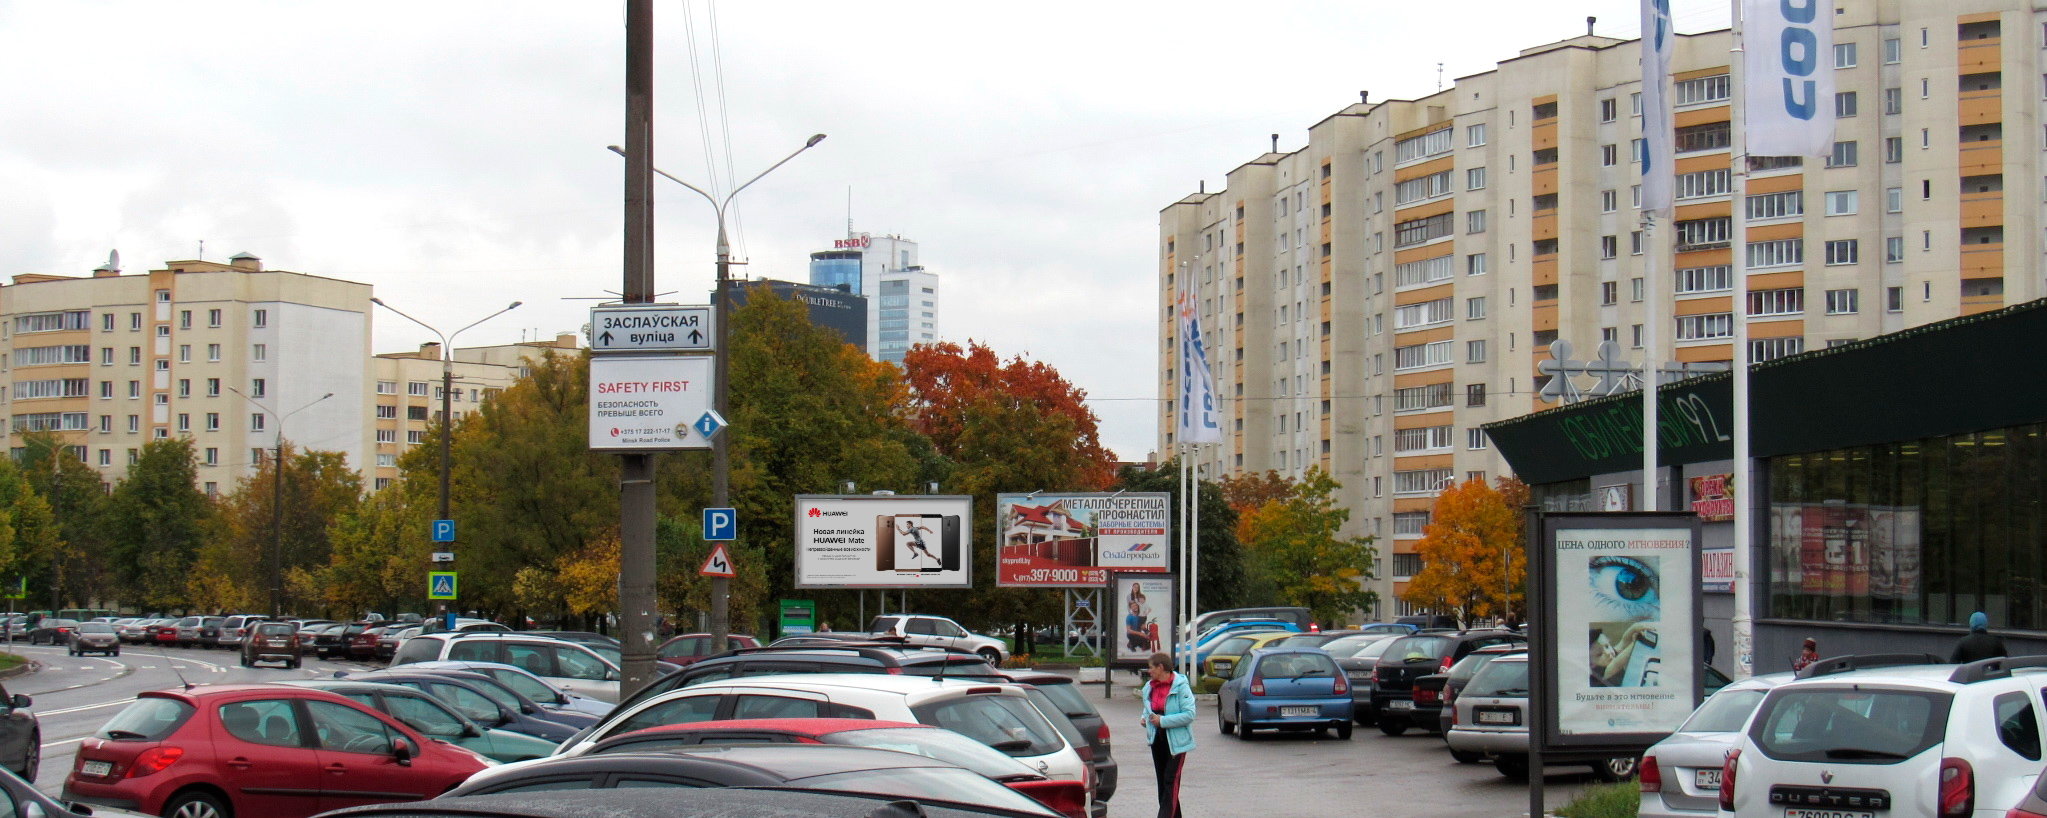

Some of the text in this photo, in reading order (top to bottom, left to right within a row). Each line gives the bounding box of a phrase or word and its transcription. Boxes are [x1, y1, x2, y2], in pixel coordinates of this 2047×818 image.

[604, 314, 699, 329] ЗАСЛАЎСКАЯ
[630, 331, 675, 345] вуліца
[598, 381, 689, 393] SAFETY FIRST
[598, 401, 659, 409] БЕЗОПАСНОСТЬ
[597, 410, 637, 418] ПРЕВЫШЕ
[1063, 499, 1164, 510] МЕТАЛЛОЧЕРЕПИЦА
[1099, 510, 1164, 520] ПРОФНАСТИЛ
[1558, 540, 1584, 550] ЦЕНА
[1587, 540, 1625, 550] ОДНОГО
[1703, 552, 1733, 578] МАГАЗИН
[1576, 693, 1605, 702] Будьте
[1772, 794, 1882, 807] DUSTER
